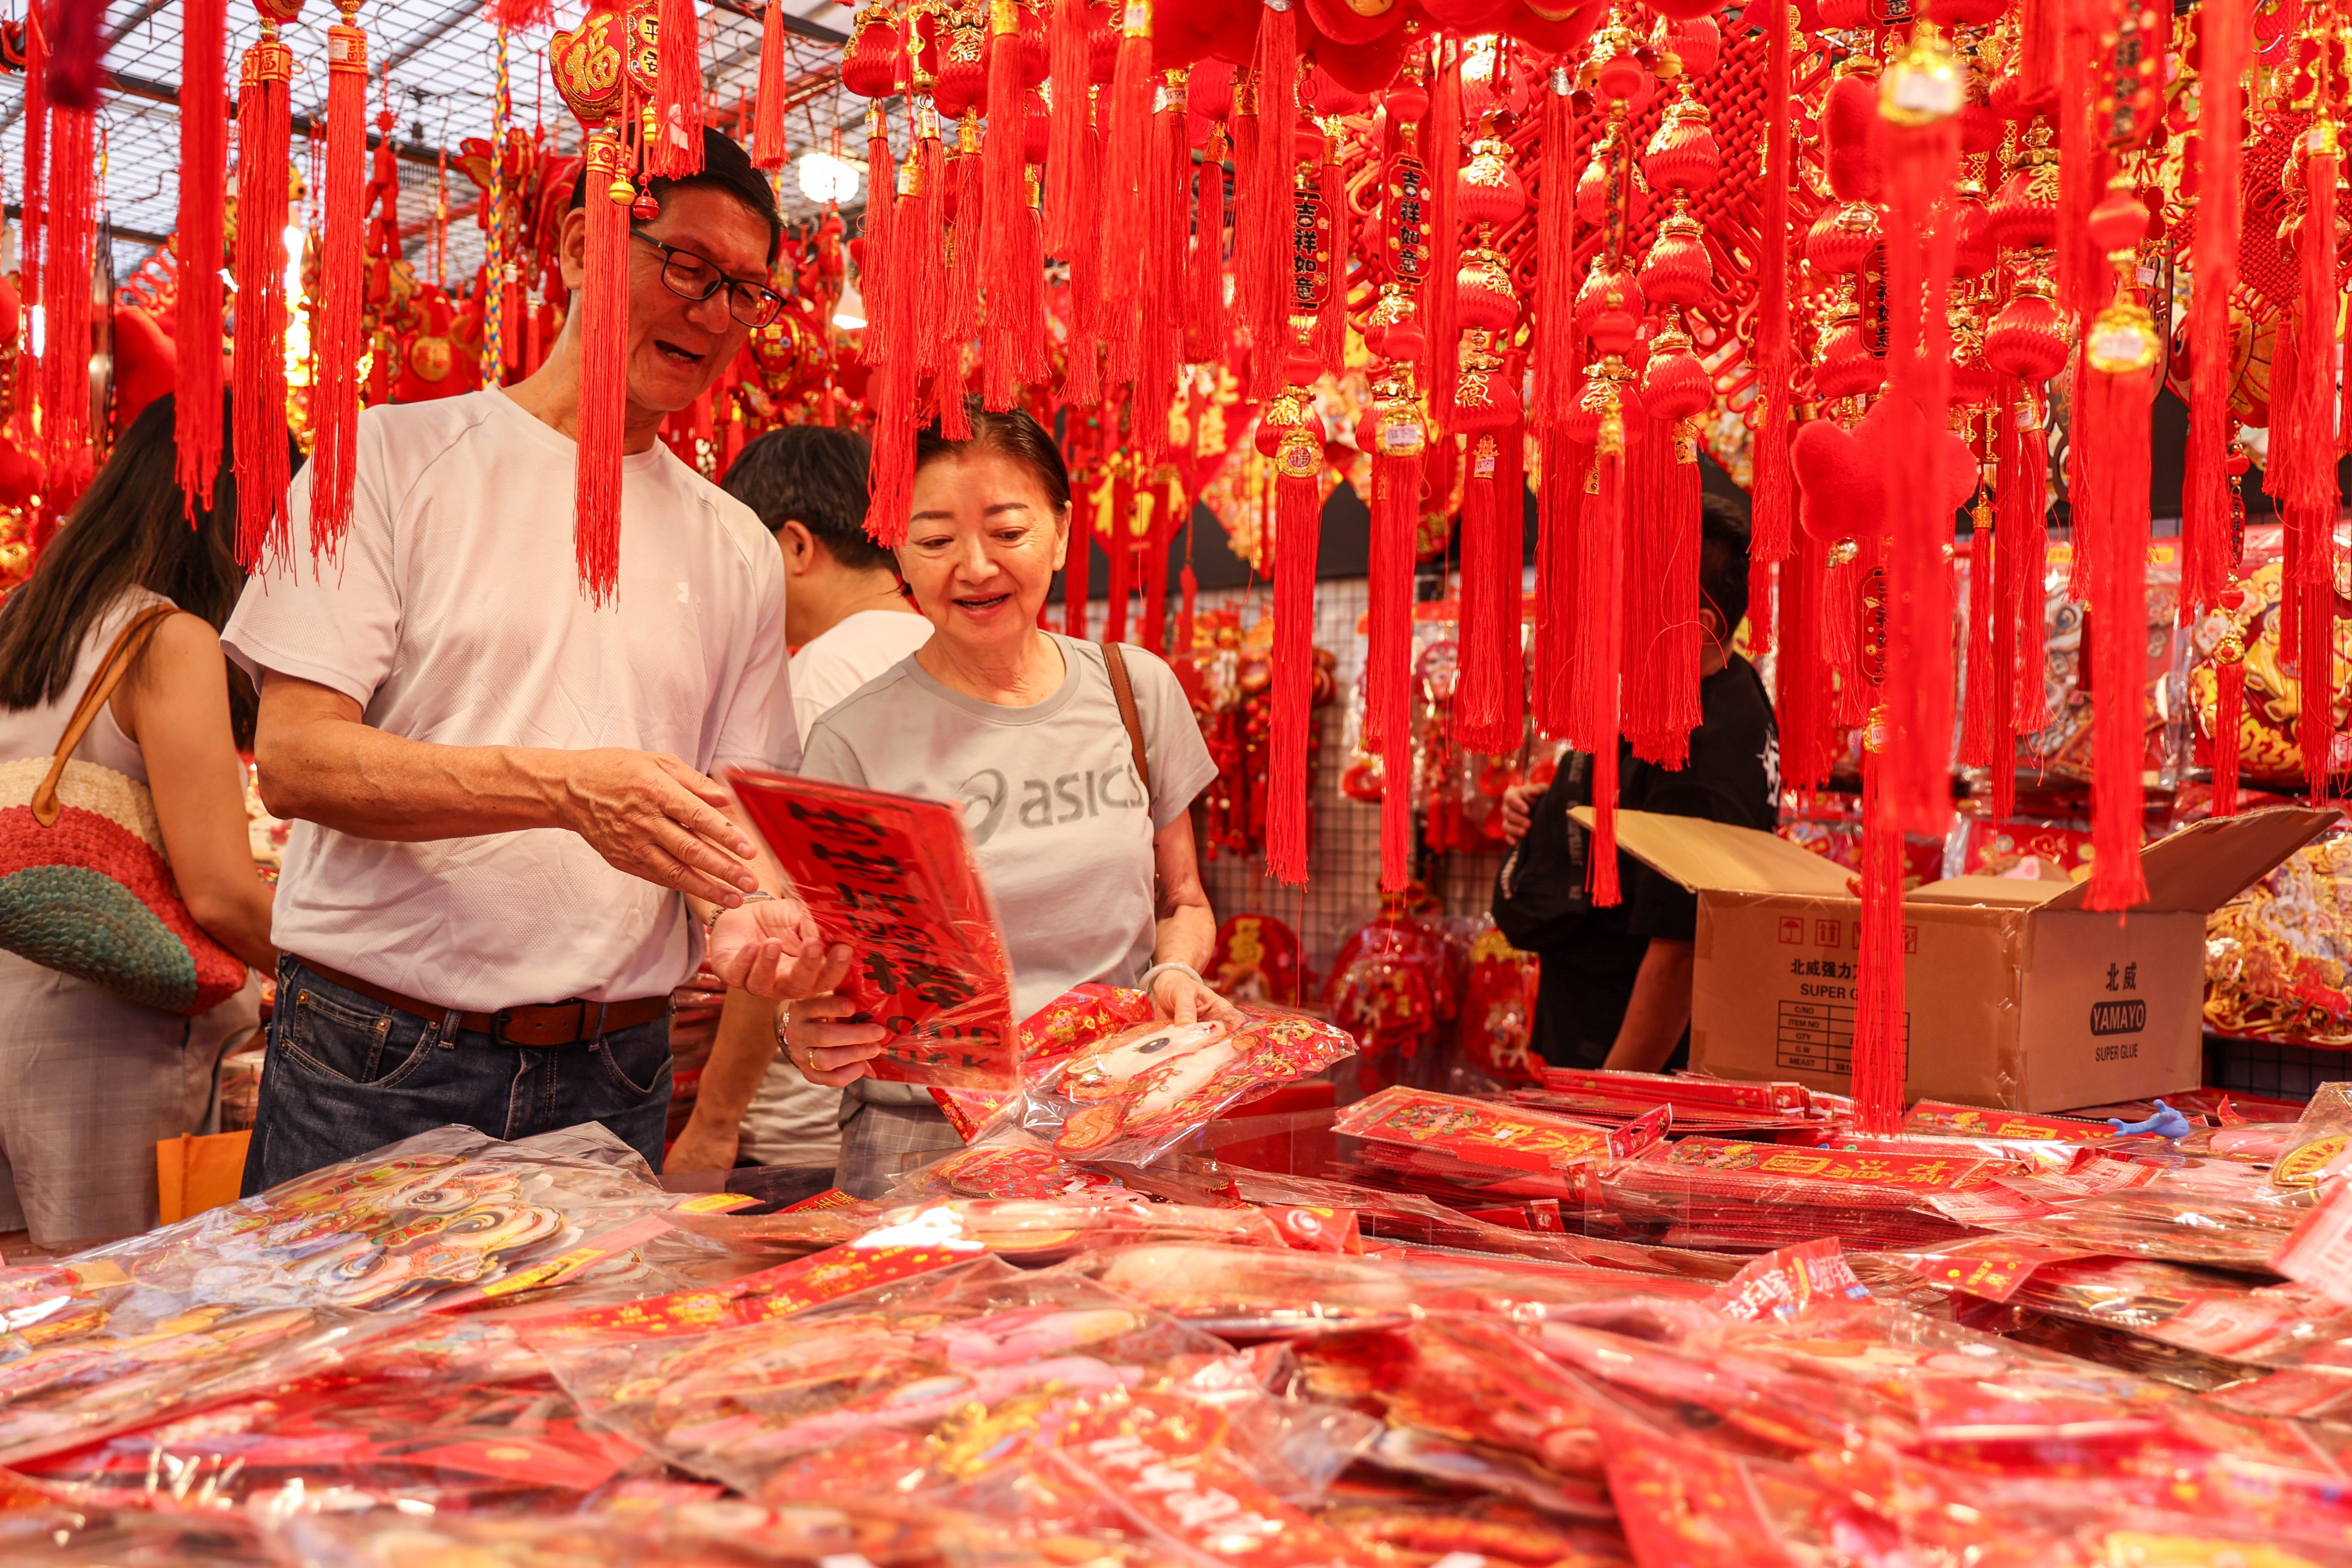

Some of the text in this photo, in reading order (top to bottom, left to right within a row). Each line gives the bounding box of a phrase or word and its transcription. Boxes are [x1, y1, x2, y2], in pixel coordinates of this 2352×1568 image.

[564, 13, 622, 95] 福
[1398, 169, 1421, 274] 吉祥如意
[1293, 201, 1318, 300] 吉祥如意
[1460, 383, 1482, 407] 福
[1291, 447, 1310, 467] 福
[2105, 962, 2137, 992] 北威
[1800, 983, 1846, 999] SUPER
[1794, 1006, 1814, 1015] C/NO
[2094, 1004, 2144, 1031] YAMAYO
[1795, 1032, 1811, 1041] QTY
[1789, 1057, 1815, 1067] MEAST
[2095, 1043, 2138, 1062] SUPER GLUE
